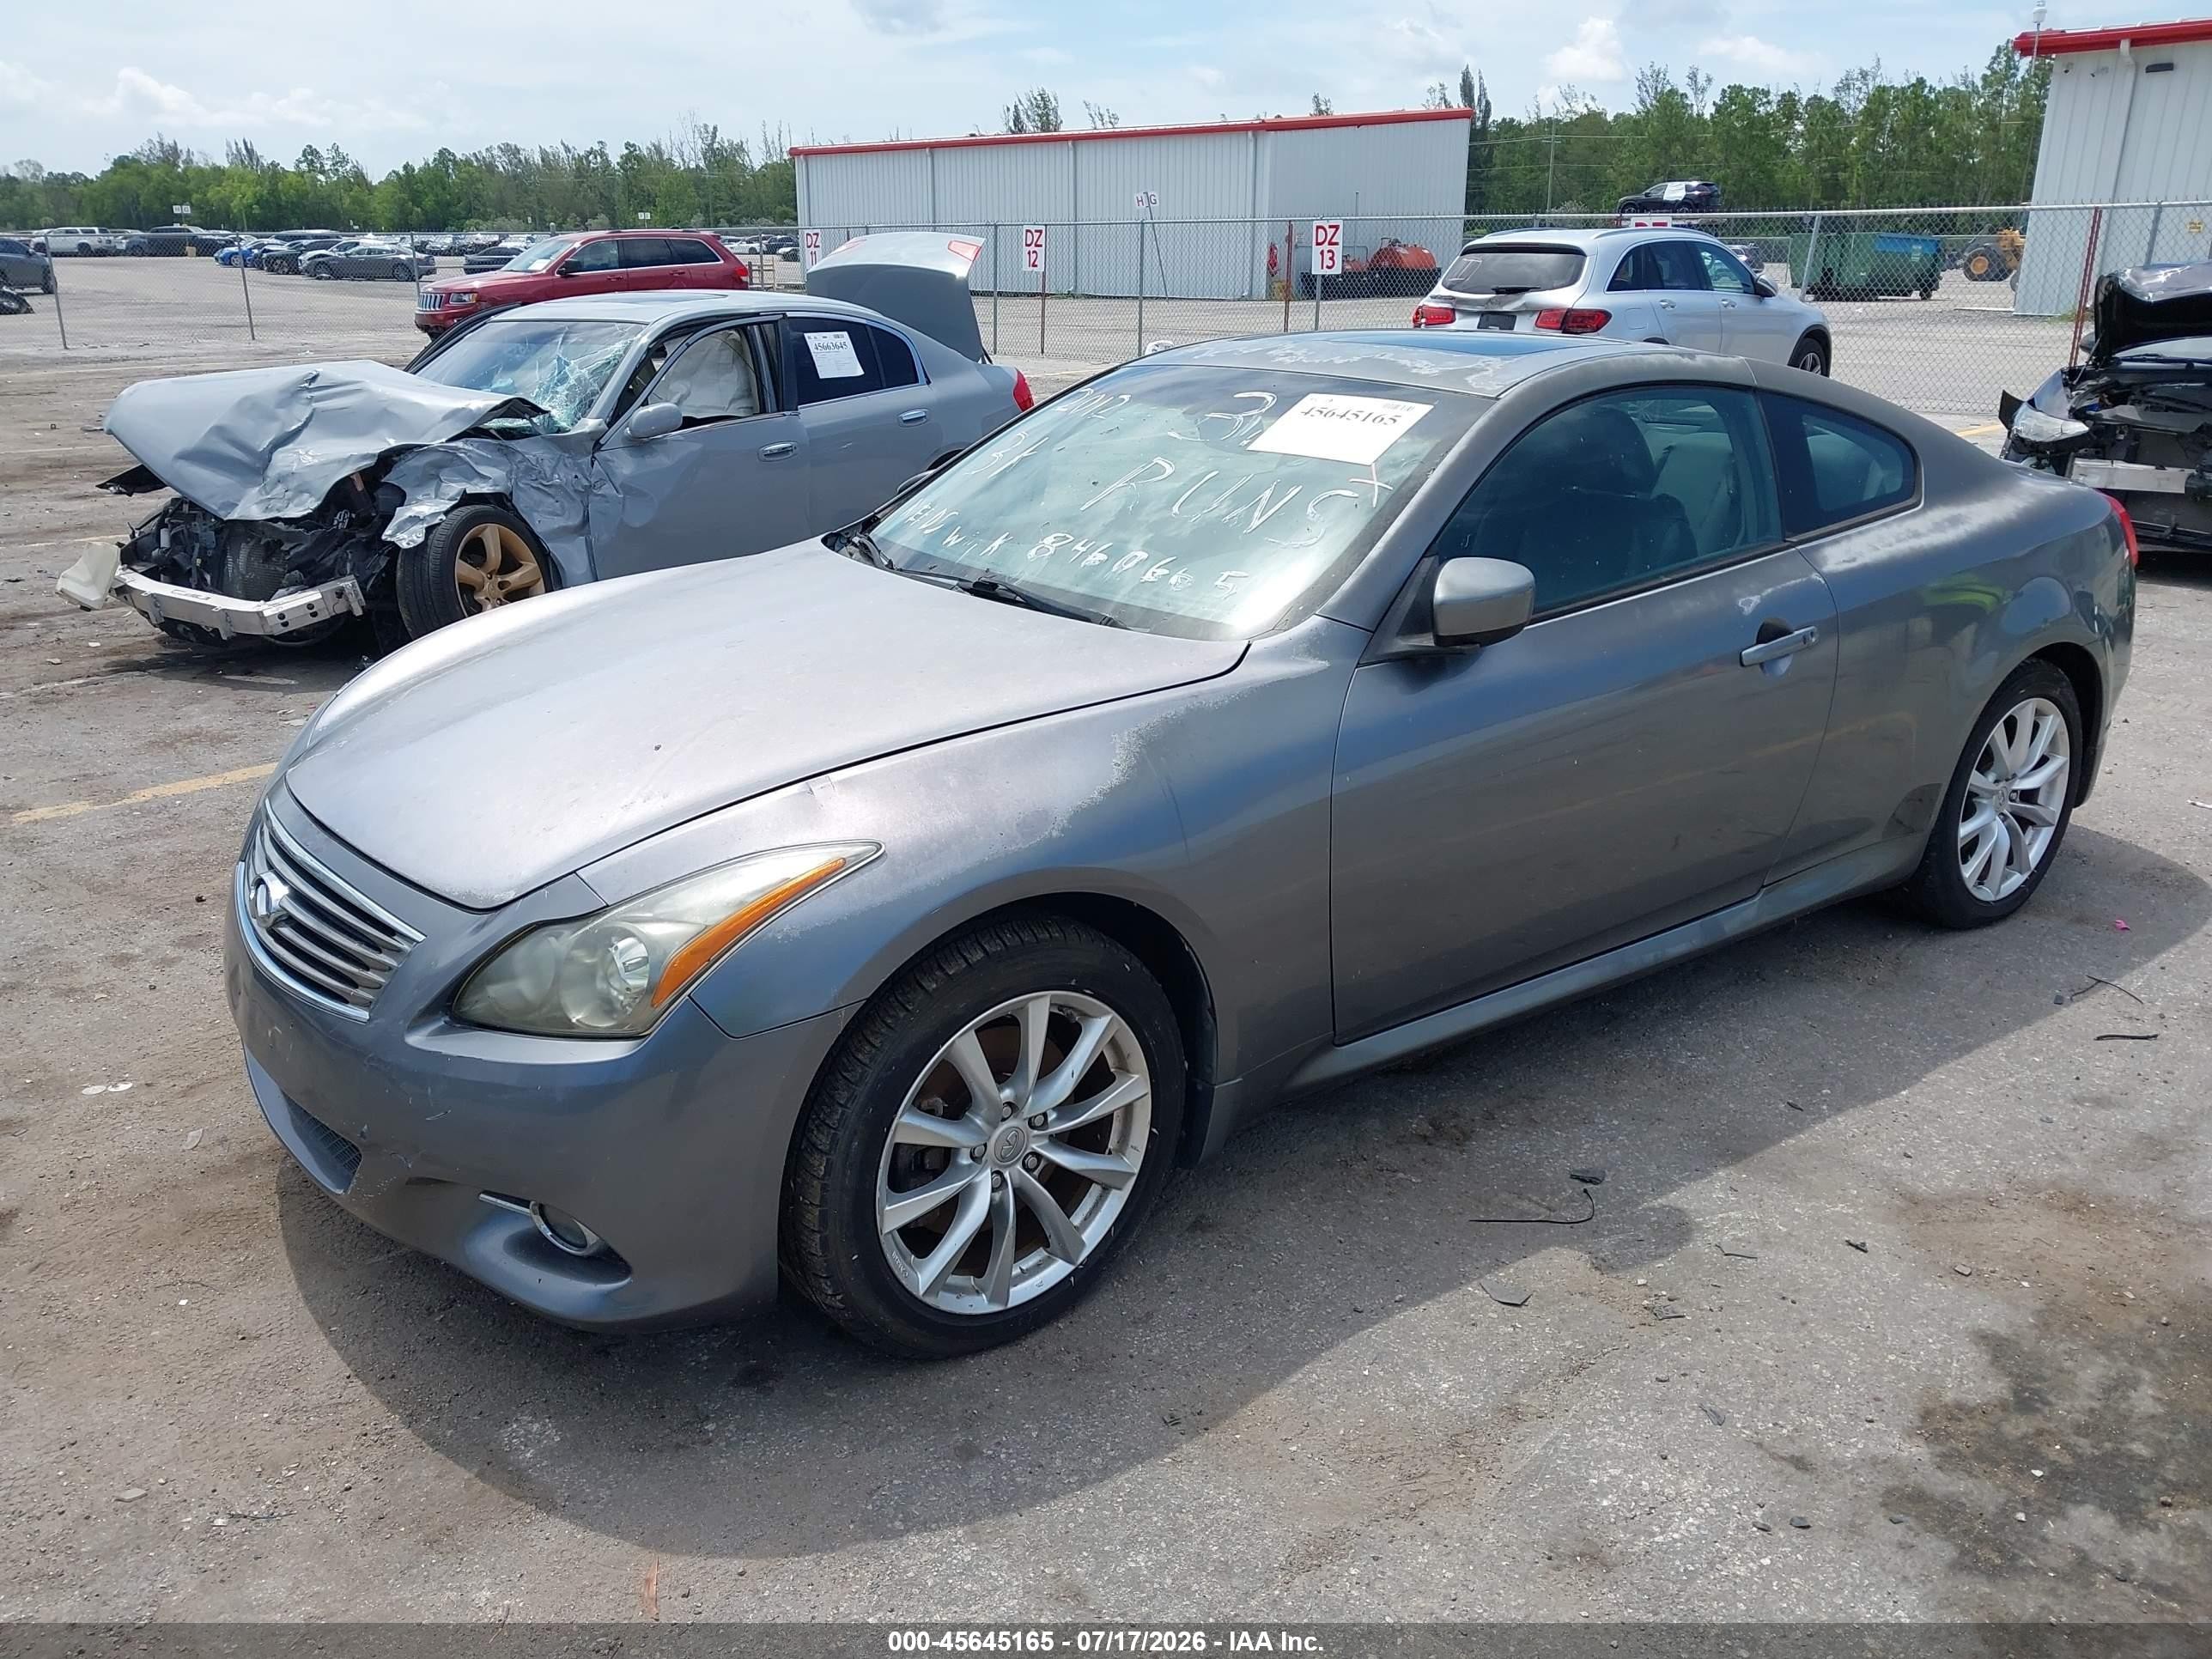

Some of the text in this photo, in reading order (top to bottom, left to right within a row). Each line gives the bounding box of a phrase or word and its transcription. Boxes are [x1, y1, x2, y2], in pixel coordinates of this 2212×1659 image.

[1136, 194, 1157, 206] H G
[806, 233, 820, 248] DZ
[1025, 229, 1042, 247] DZ
[1316, 225, 1340, 246] DZ
[811, 251, 817, 266] 11
[1027, 250, 1038, 267] 12
[1320, 249, 1335, 270] 13
[1301, 406, 1401, 426] 45645165
[1079, 457, 1358, 549] RUNS
